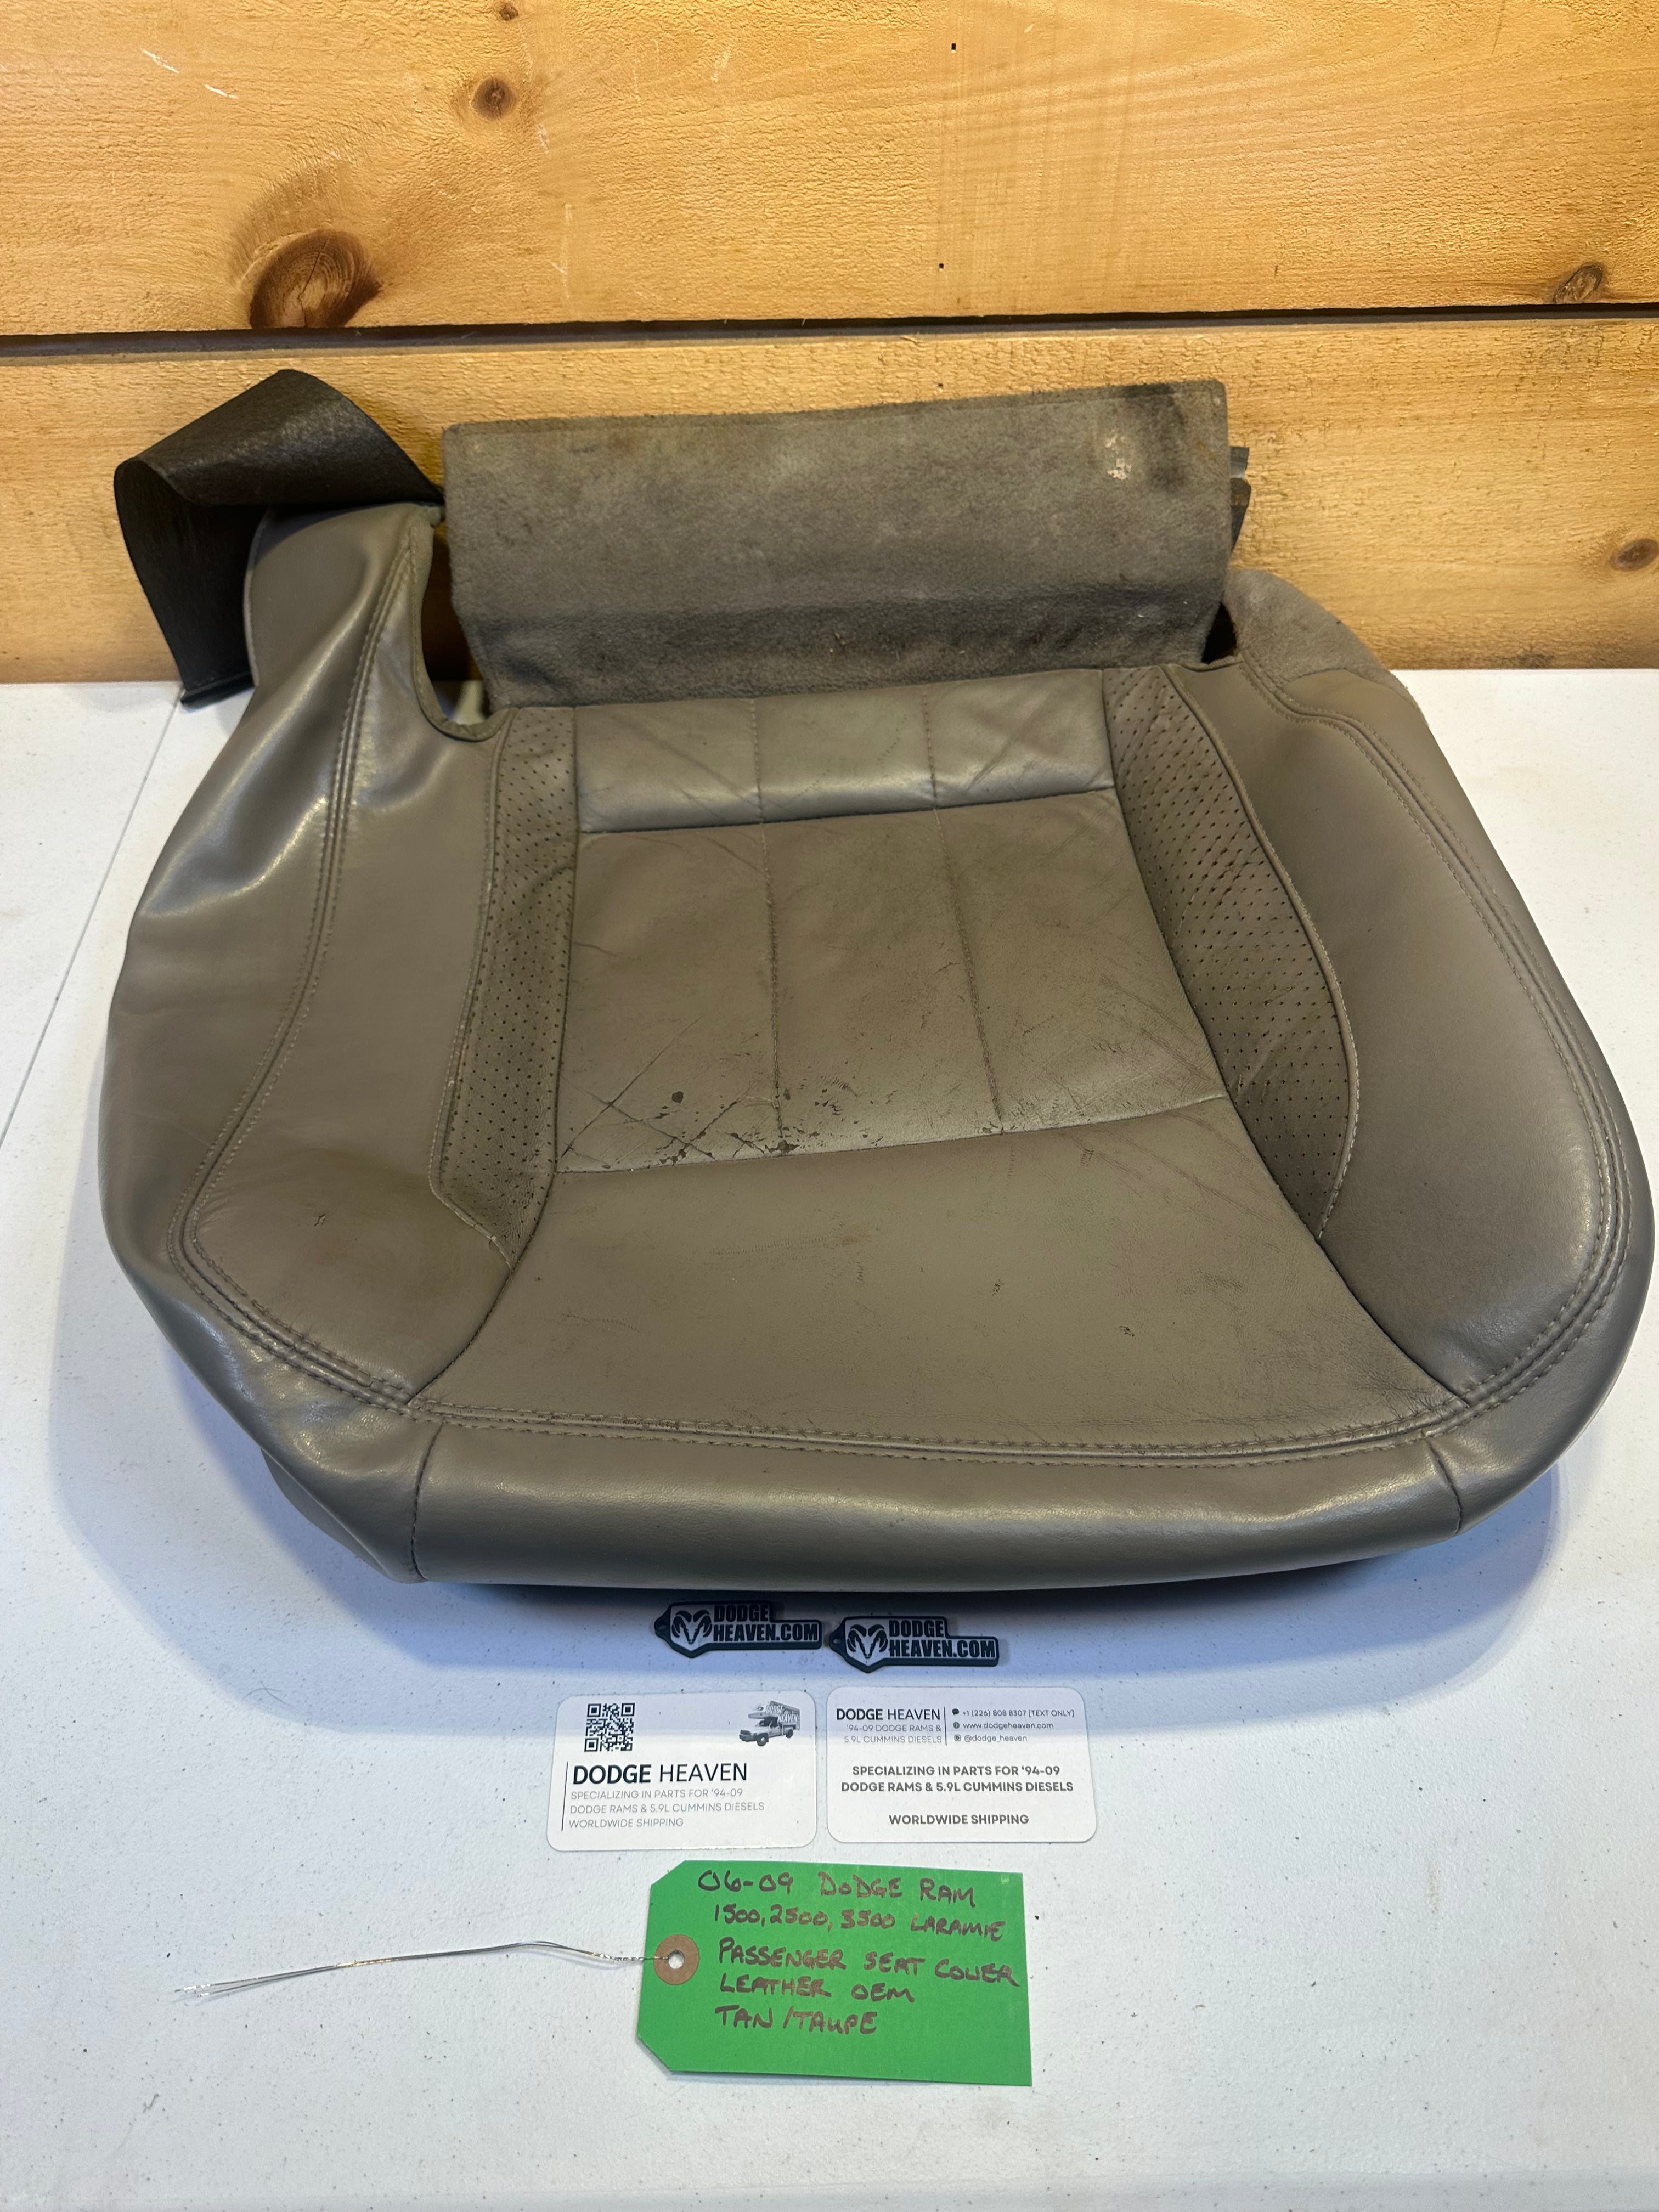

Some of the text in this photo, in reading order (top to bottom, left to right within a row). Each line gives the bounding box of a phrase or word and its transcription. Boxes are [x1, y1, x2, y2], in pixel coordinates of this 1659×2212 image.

[714, 1604, 768, 1622] DODGE
[713, 1623, 819, 1641] HEAVEN.COM
[889, 1620, 944, 1637] DODGE
[889, 1640, 995, 1657] HEAVEN.COM
[765, 1702, 783, 1713] DODGE
[777, 1713, 798, 1723] HEAVEN
[836, 1708, 940, 1720] DODGE HEAVEN
[963, 1722, 1054, 1730] www.dodgeheaven.com
[862, 1735, 906, 1743] CUMMINS
[964, 1734, 1028, 1743] @dodge_heaven
[573, 1763, 747, 1784] DODGE HEAVEN
[853, 1765, 935, 1775] SPECIALIZING
[938, 1766, 950, 1775] IN
[953, 1765, 992, 1775] PARTS
[995, 1766, 1019, 1775] FOR
[841, 1782, 1073, 1792] DODGE RAMS & 5.9L CUMMINS DIESELS
[571, 1790, 639, 1800] SPECIALIZING
[641, 1790, 651, 1798] IN
[655, 1790, 686, 1798] PARTS
[689, 1789, 708, 1797] FOR
[570, 1802, 764, 1814] DODGE RAMS & 5.9L CUMMINS DIESELS
[569, 1818, 684, 1829] WORLDWIDE SHIPPING
[889, 1814, 1029, 1825] WORLDWIDE SHIPPING
[698, 1870, 793, 1895] 06-09
[920, 1878, 976, 1908] RAM
[910, 1914, 1006, 1942] LARAMIE
[719, 1937, 847, 1970] PASSENGER
[864, 1952, 926, 1975] SEAT
[720, 1973, 915, 2003] LEATHER OEM
[715, 2005, 772, 2028] TAN
